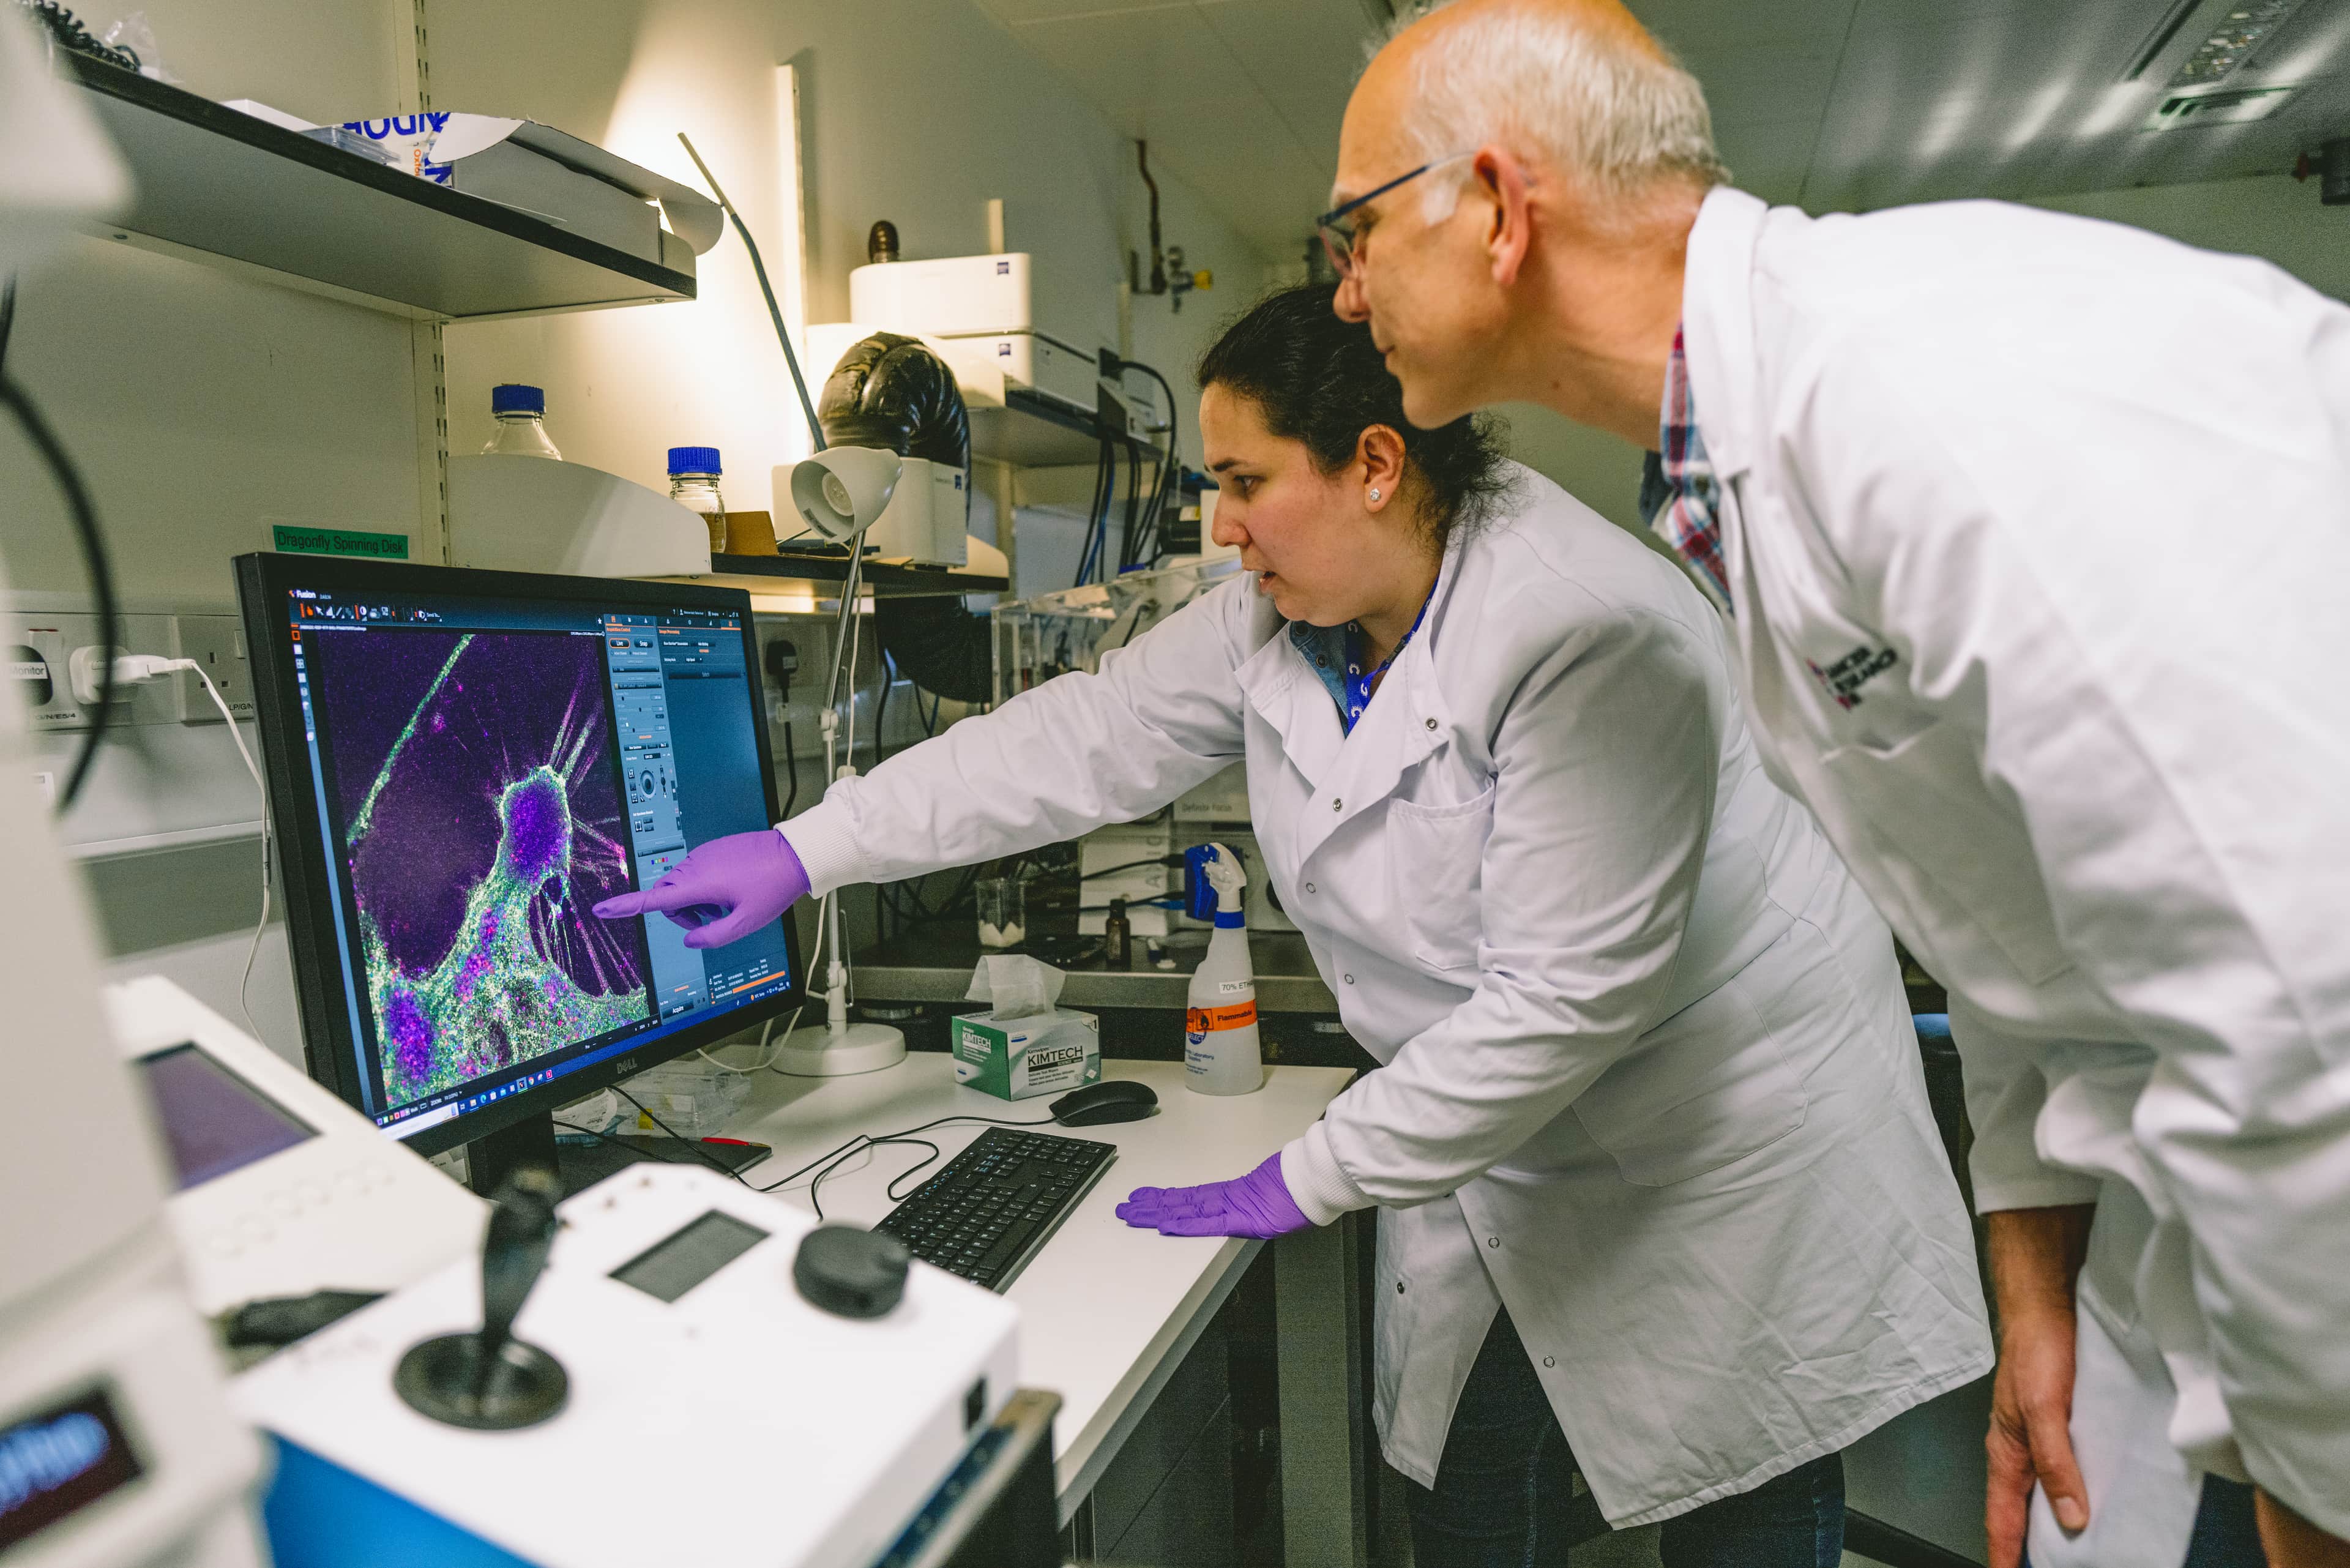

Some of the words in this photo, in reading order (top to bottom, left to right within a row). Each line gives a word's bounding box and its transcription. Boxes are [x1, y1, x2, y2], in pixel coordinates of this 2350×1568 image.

[277, 531, 330, 551] Dragonfly
[334, 536, 379, 553] Spinning
[382, 539, 403, 554] Disk
[296, 589, 316, 599] Fusion
[11, 666, 45, 675] Monitor
[1217, 1010, 1253, 1022] Flammable
[963, 1031, 991, 1048] KIMTECH
[1028, 1045, 1083, 1067] KIMTECH
[616, 1057, 638, 1075] DELL
